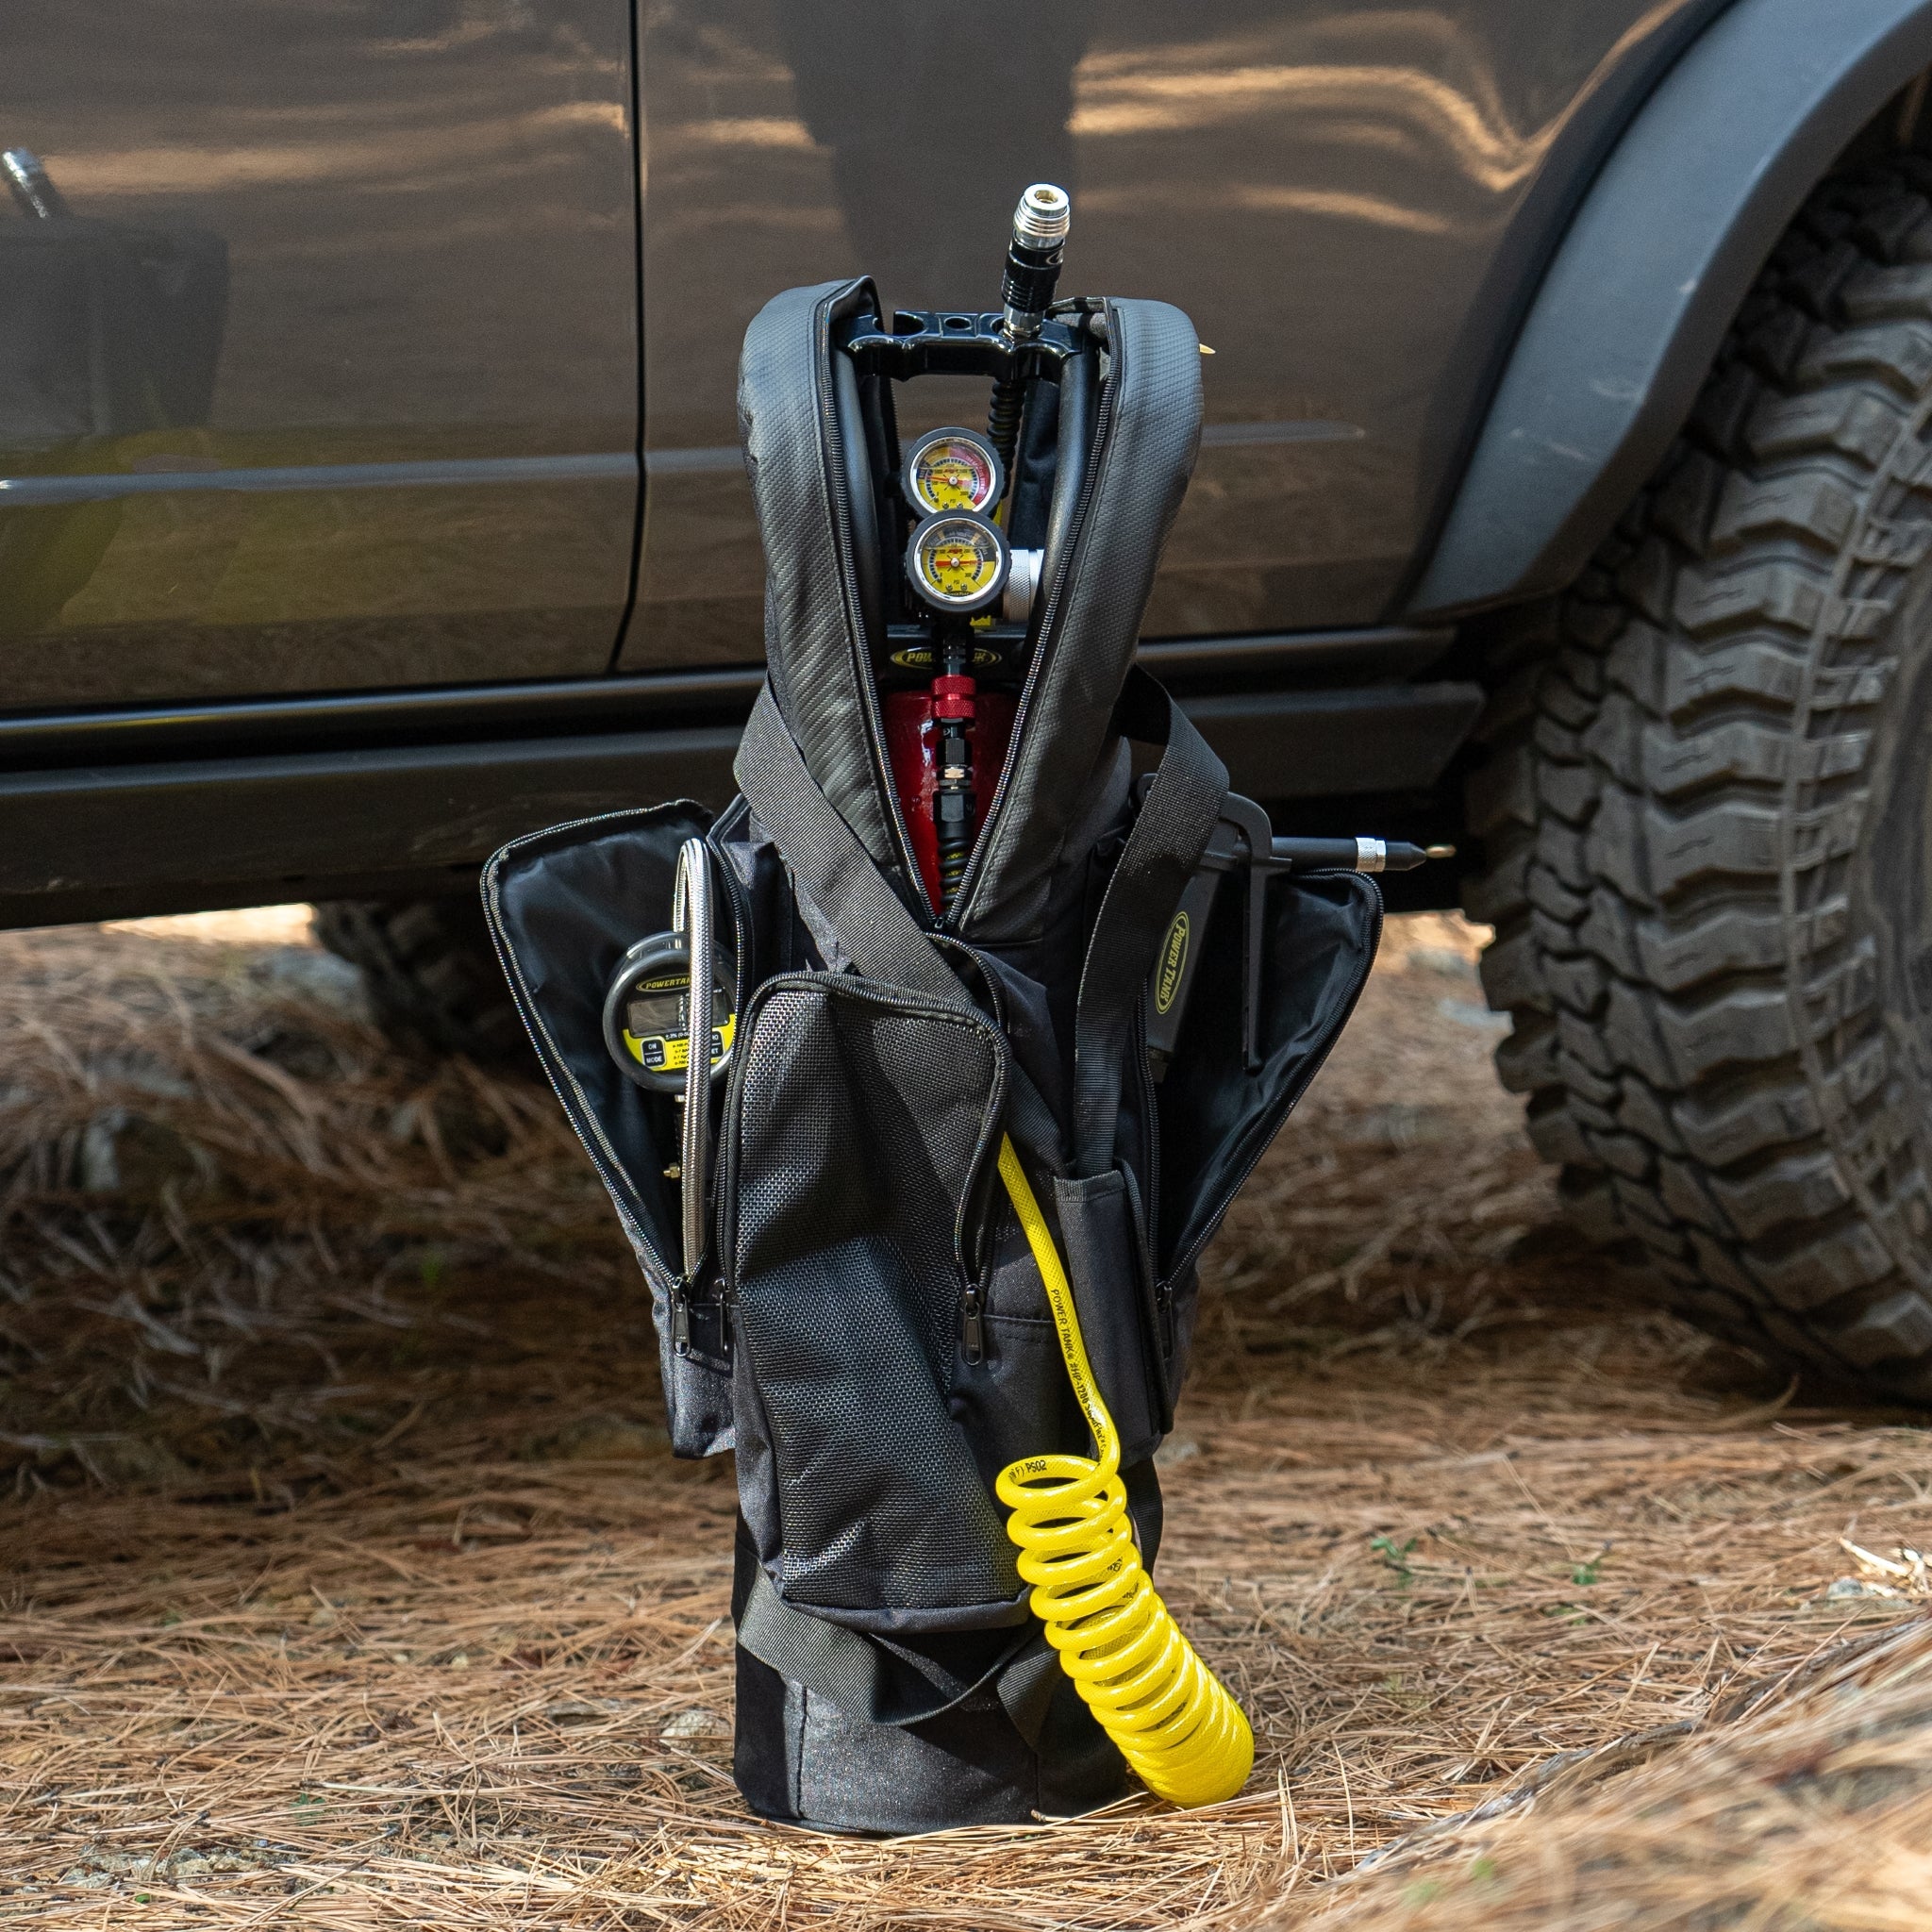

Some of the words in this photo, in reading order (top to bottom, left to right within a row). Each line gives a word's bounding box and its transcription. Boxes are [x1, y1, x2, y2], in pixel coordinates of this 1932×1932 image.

[907, 653, 933, 662] POW
[1168, 924, 1186, 968] POWER
[645, 977, 690, 989] POWERTA
[1160, 967, 1176, 1001] TANK
[646, 1056, 662, 1064] MODE
[1051, 1289, 1068, 1325] POWER
